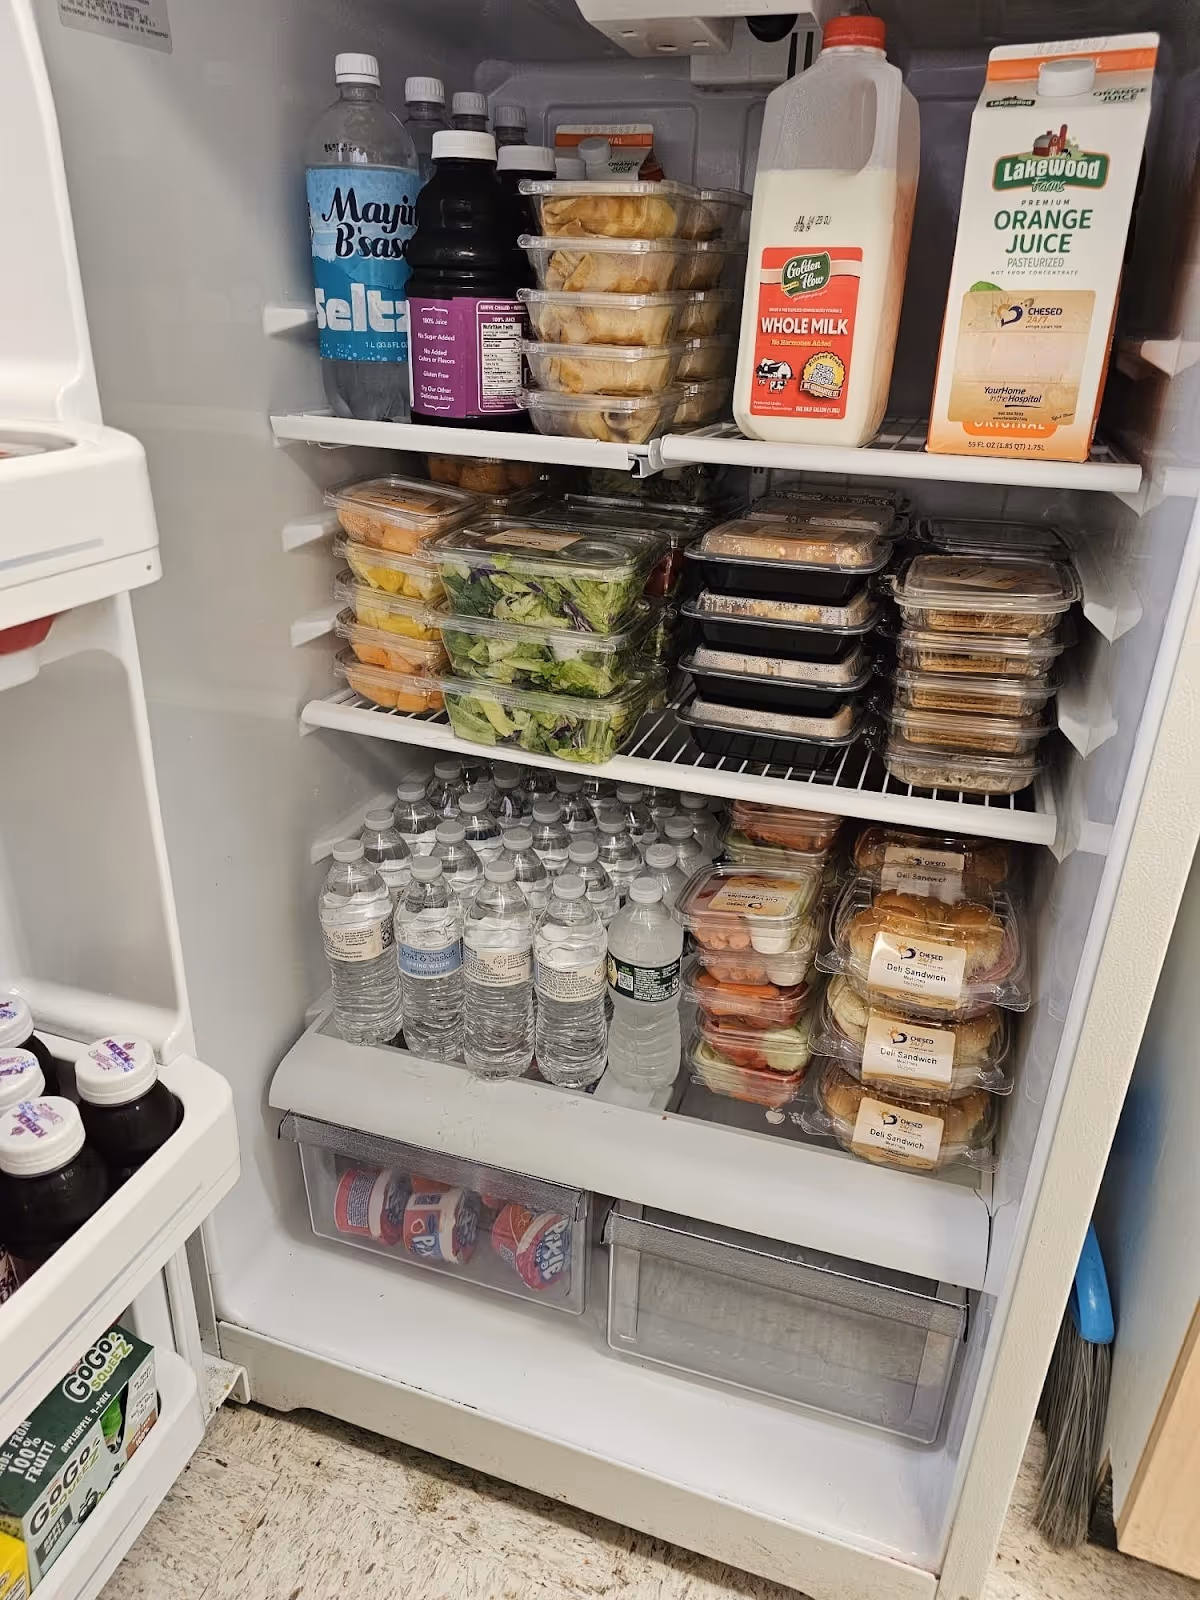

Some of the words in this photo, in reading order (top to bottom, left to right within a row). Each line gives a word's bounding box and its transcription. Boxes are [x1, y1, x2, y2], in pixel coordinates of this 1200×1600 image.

[1093, 87, 1147, 97] ORANGE
[1003, 159, 1101, 181] Lakewood
[1031, 176, 1066, 192] Farms
[993, 209, 1093, 230] ORANGE
[1005, 233, 1073, 253] JUICE
[786, 259, 821, 279] Golden
[1007, 257, 1065, 268] PASTEURIZED
[800, 273, 824, 289] Flow
[1026, 316, 1049, 324] 24/7
[1027, 307, 1063, 316] CHESED
[761, 317, 808, 334] WHOLE
[811, 318, 849, 335] MILK
[424, 333, 437, 341] Sugar
[1008, 395, 1042, 404] Hospital
[919, 951, 943, 961] CHESED
[887, 963, 903, 973] Deli
[904, 968, 946, 982] Sandwich
[910, 1035, 934, 1045] CHESED
[880, 1047, 895, 1057] Deli
[897, 1051, 937, 1065] Sandwich
[900, 1118, 923, 1129] CHESED
[870, 1128, 885, 1138] Deli
[886, 1133, 924, 1150] Sandwich
[91, 1341, 132, 1390] SQUEEZ
[9, 1420, 32, 1448] FROM
[60, 1415, 93, 1453] APPLEAPPLE
[8, 1437, 42, 1475] 100%
[25, 1440, 57, 1484] FRUIT!
[49, 1447, 99, 1520] SQUEEZ
